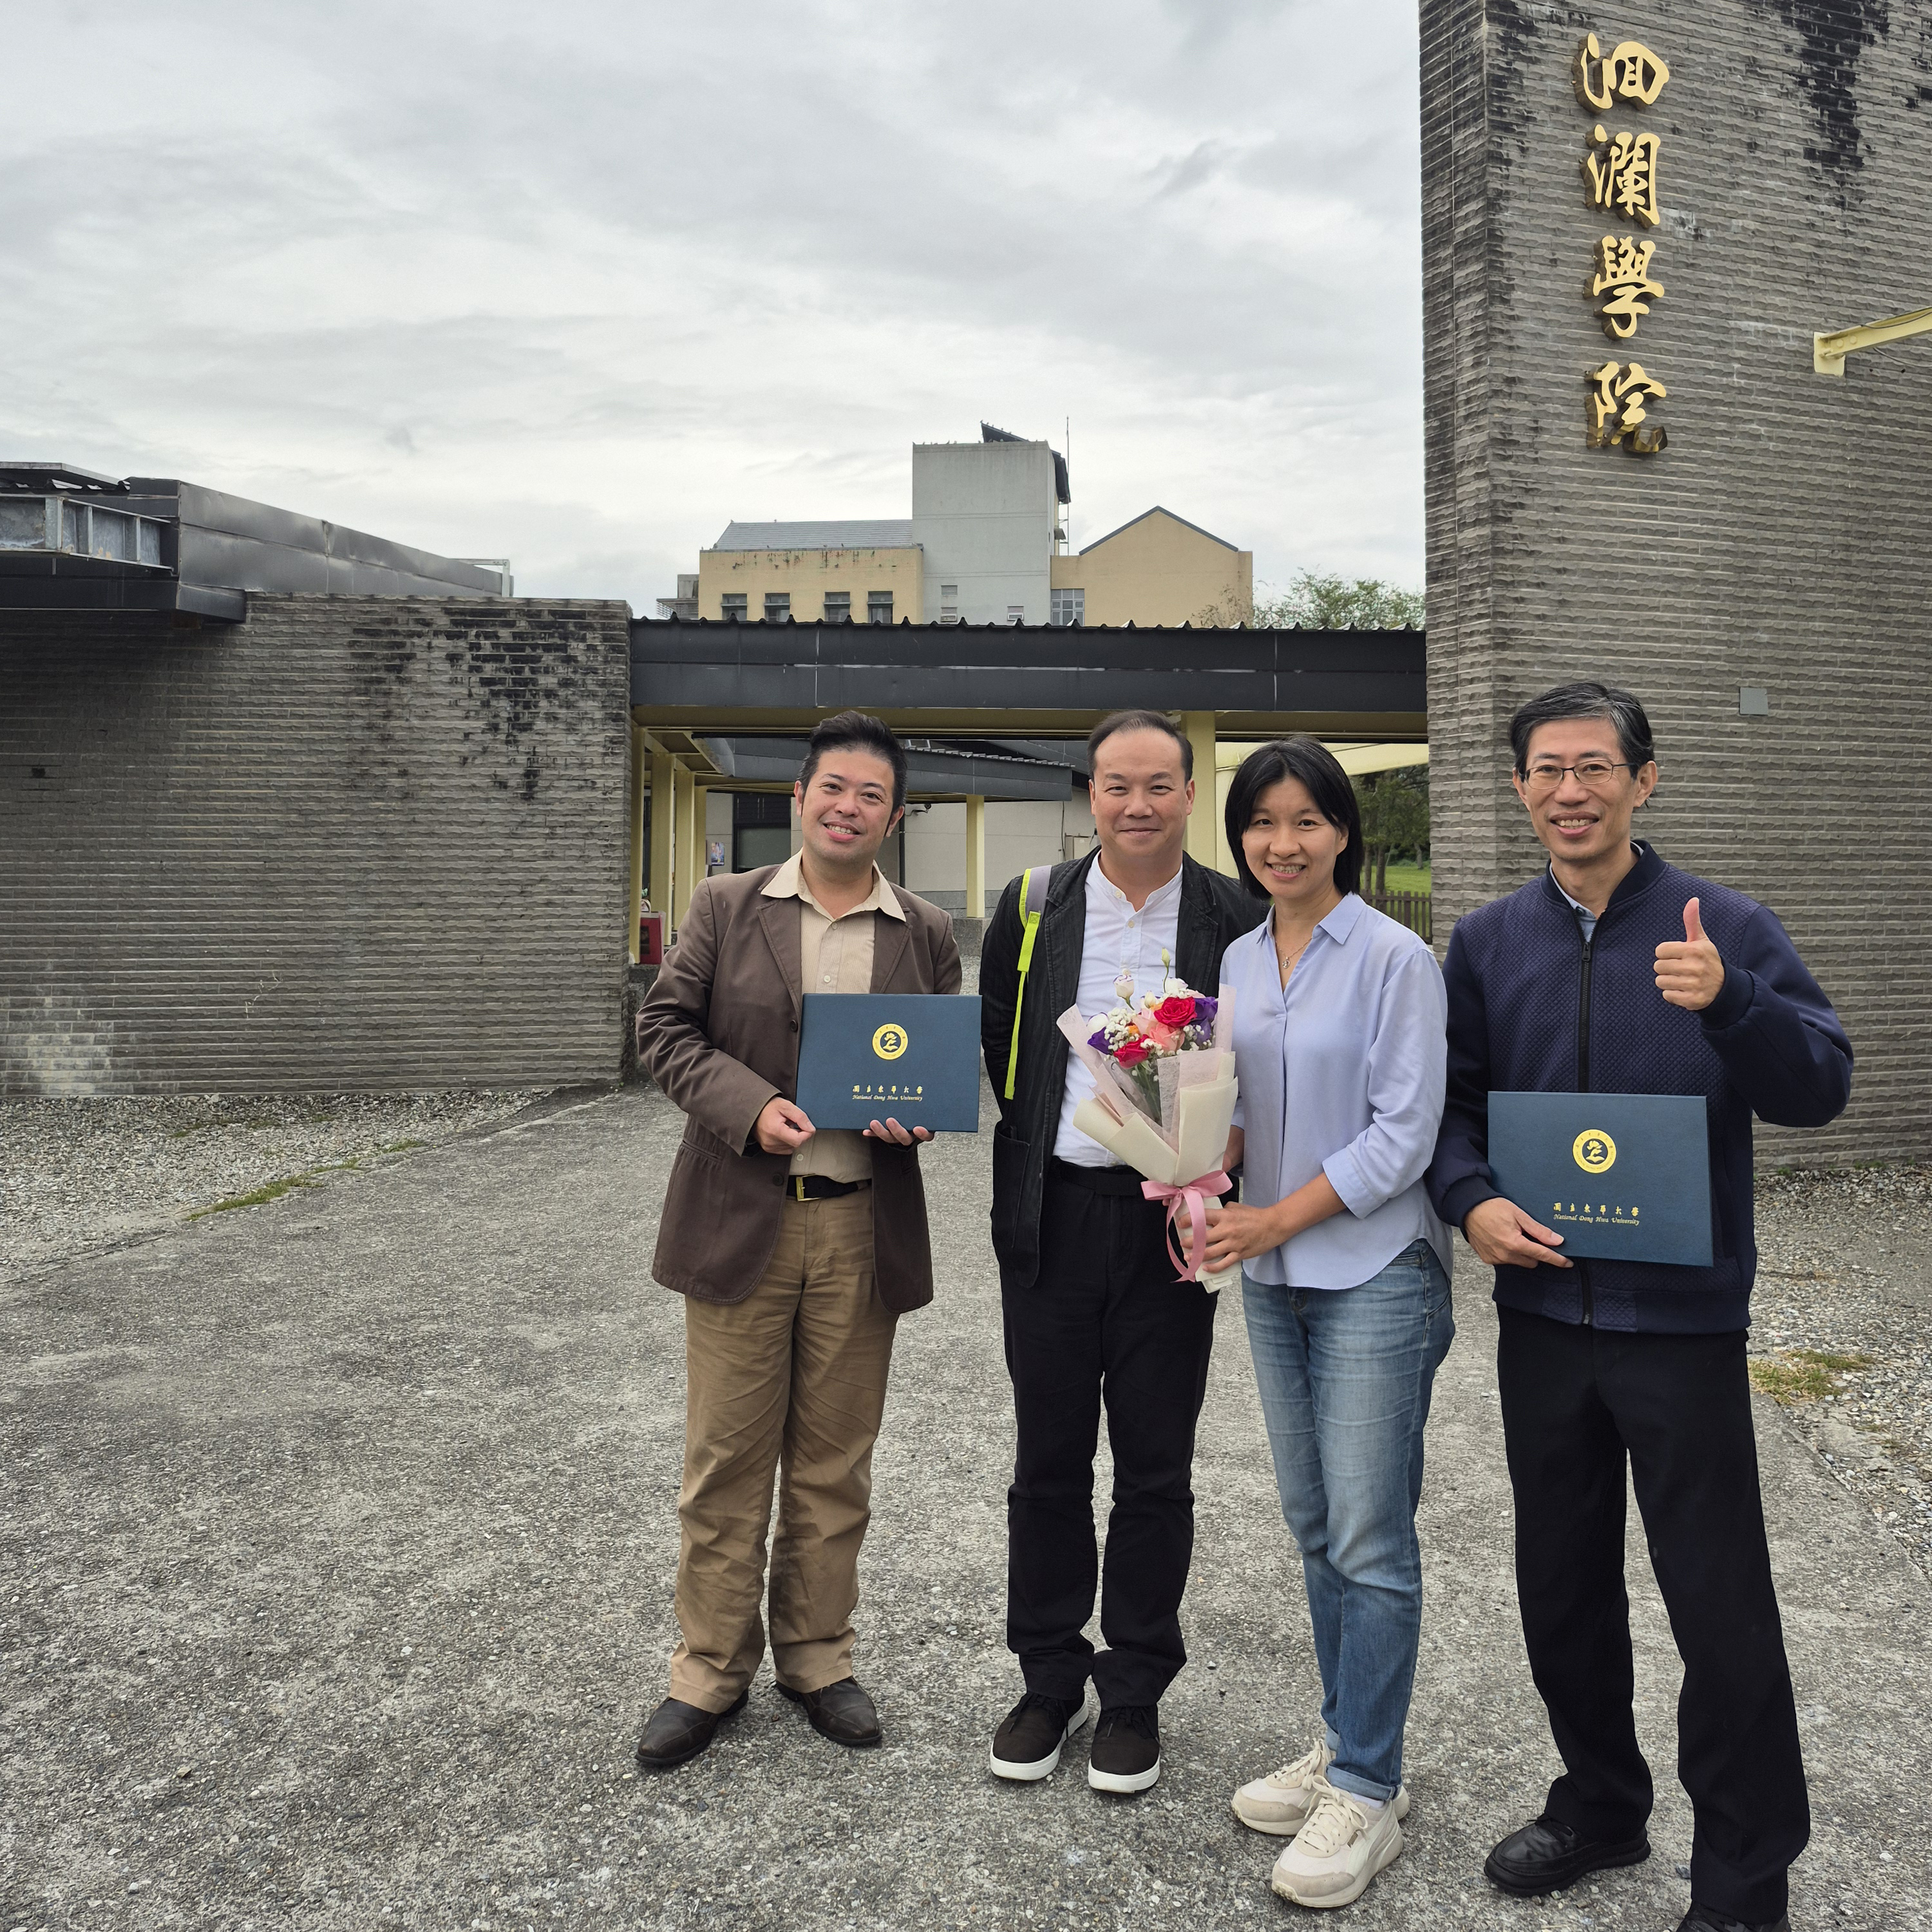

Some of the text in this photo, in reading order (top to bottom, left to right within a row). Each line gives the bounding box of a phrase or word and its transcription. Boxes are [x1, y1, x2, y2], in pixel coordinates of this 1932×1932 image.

[1577, 32, 1669, 453] 洄瀾學院
[1611, 1217, 1640, 1226] University
